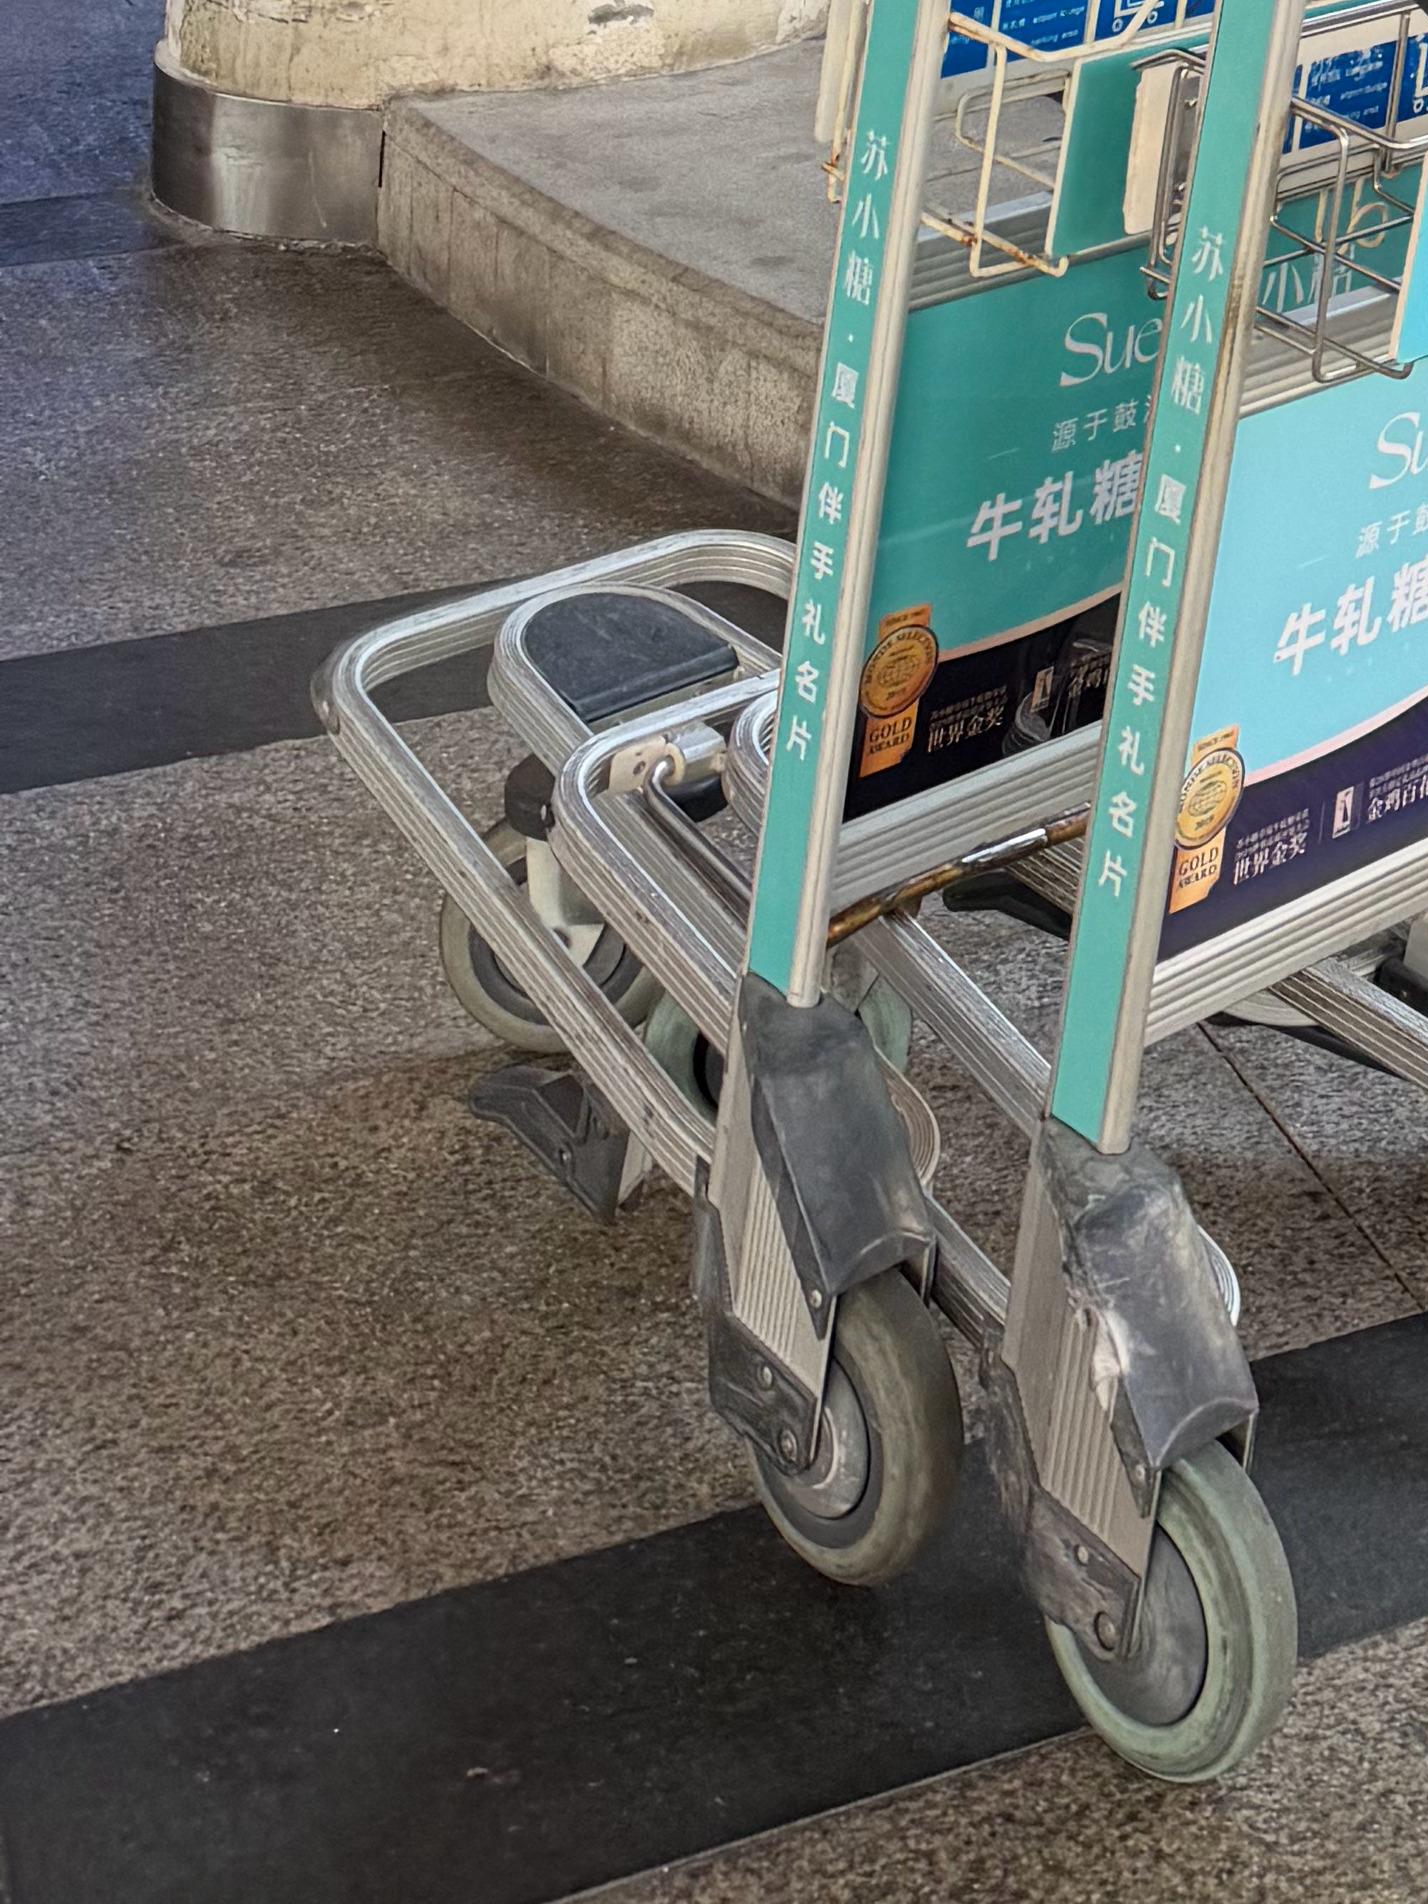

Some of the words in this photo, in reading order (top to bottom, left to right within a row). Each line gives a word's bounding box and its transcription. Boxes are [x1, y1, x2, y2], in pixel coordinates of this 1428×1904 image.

[1051, 393, 1155, 452] 源于鼓
[869, 716, 913, 743] GOLD
[1178, 846, 1220, 876] GOLD
[1233, 832, 1309, 886] 世界金奖
